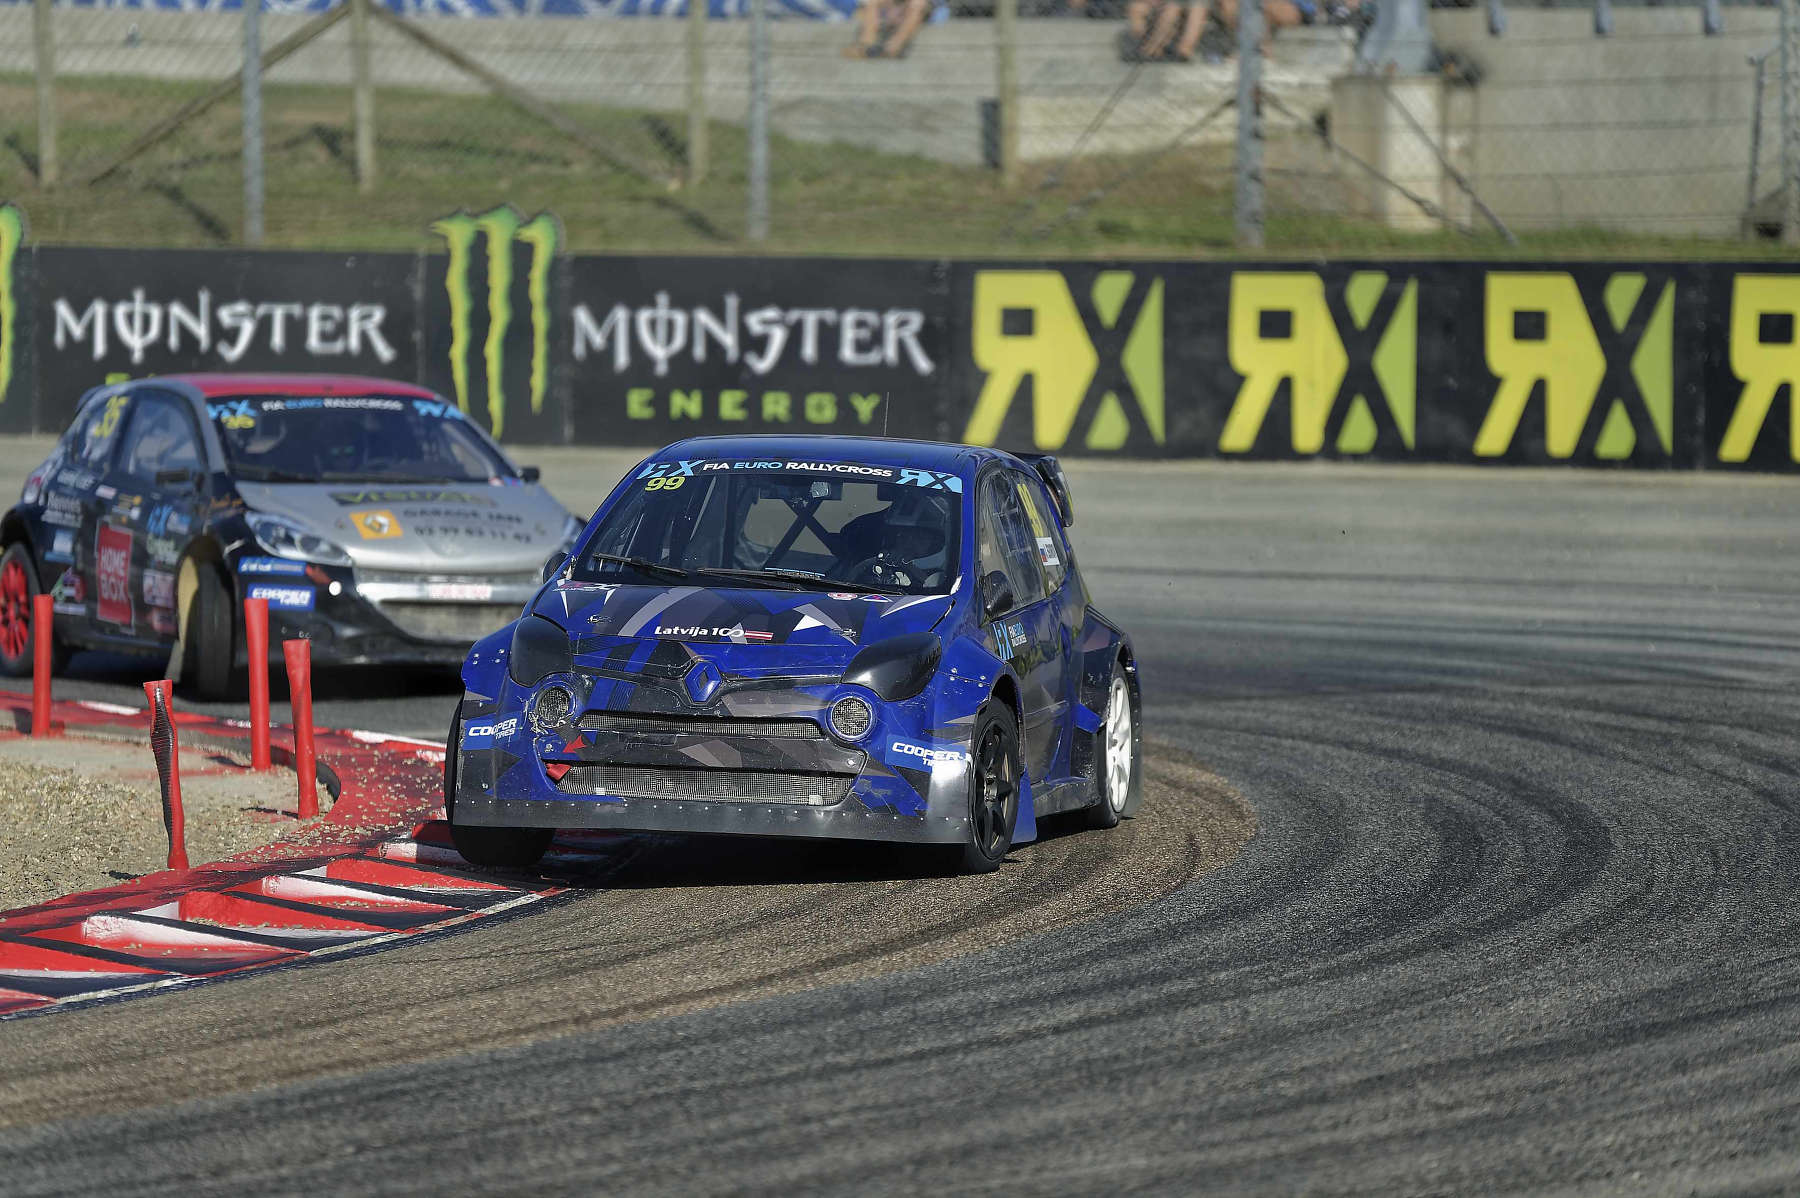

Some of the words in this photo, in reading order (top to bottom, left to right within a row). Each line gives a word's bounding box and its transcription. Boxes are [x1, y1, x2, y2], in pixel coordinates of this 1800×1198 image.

[53, 287, 397, 364] MONSTER
[571, 290, 935, 377] MONSTER
[1717, 272, 1800, 463] R
[626, 388, 882, 423] ENERGY
[703, 462, 730, 471] FIA
[733, 461, 782, 469] EURO
[786, 462, 893, 477] RALLYCROSS
[645, 476, 686, 491] 99
[101, 546, 127, 576] HOME
[101, 573, 129, 604] BOX
[654, 626, 709, 637] Latvija
[712, 627, 744, 637] 100
[468, 718, 518, 737] COOPER
[495, 728, 516, 740] TIRES
[892, 742, 960, 761] COOPER
